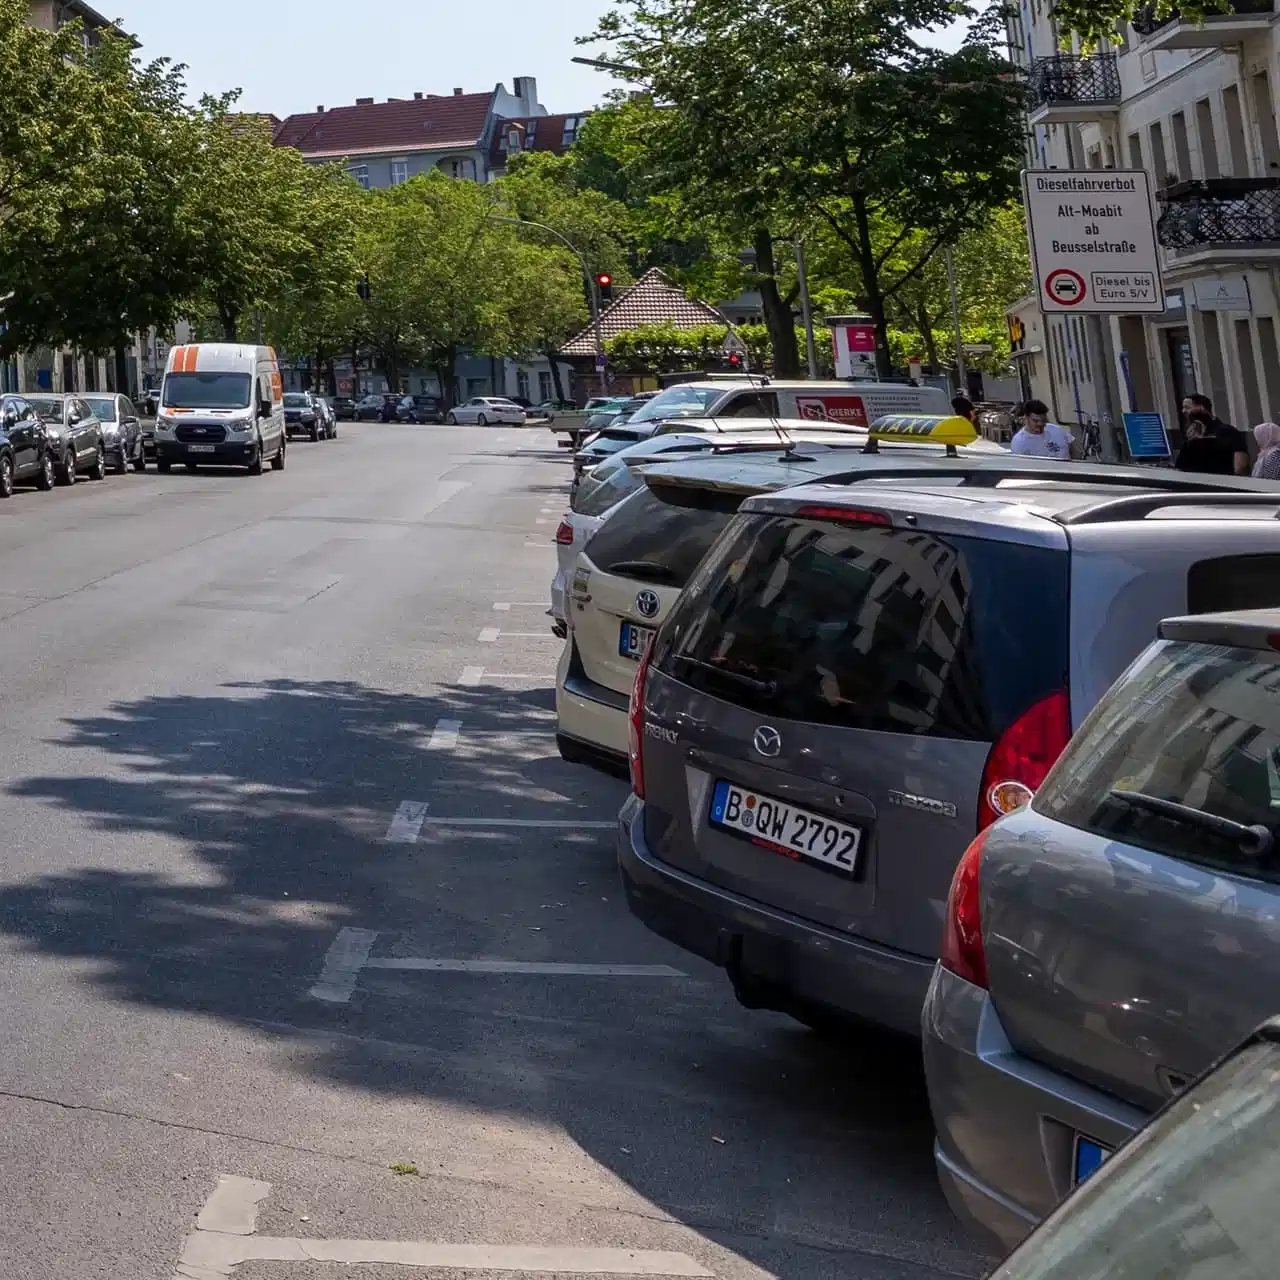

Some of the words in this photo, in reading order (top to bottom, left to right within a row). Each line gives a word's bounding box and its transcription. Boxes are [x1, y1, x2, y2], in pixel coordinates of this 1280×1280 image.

[1037, 177, 1136, 190] Dieselfahrverbot
[1057, 204, 1123, 217] Alt-Moabit
[1085, 223, 1100, 235] ab
[1052, 240, 1137, 254] Beusselstraße
[1096, 276, 1130, 286] Diesel
[1134, 276, 1151, 286] bis
[1100, 289, 1126, 298] Euro
[1130, 289, 1149, 298] 5/V
[828, 408, 864, 417] GIERKE
[878, 420, 934, 434] TAXI
[629, 628, 638, 649] B
[725, 791, 742, 822] B
[755, 801, 789, 840] QW
[790, 814, 859, 866] 2792
